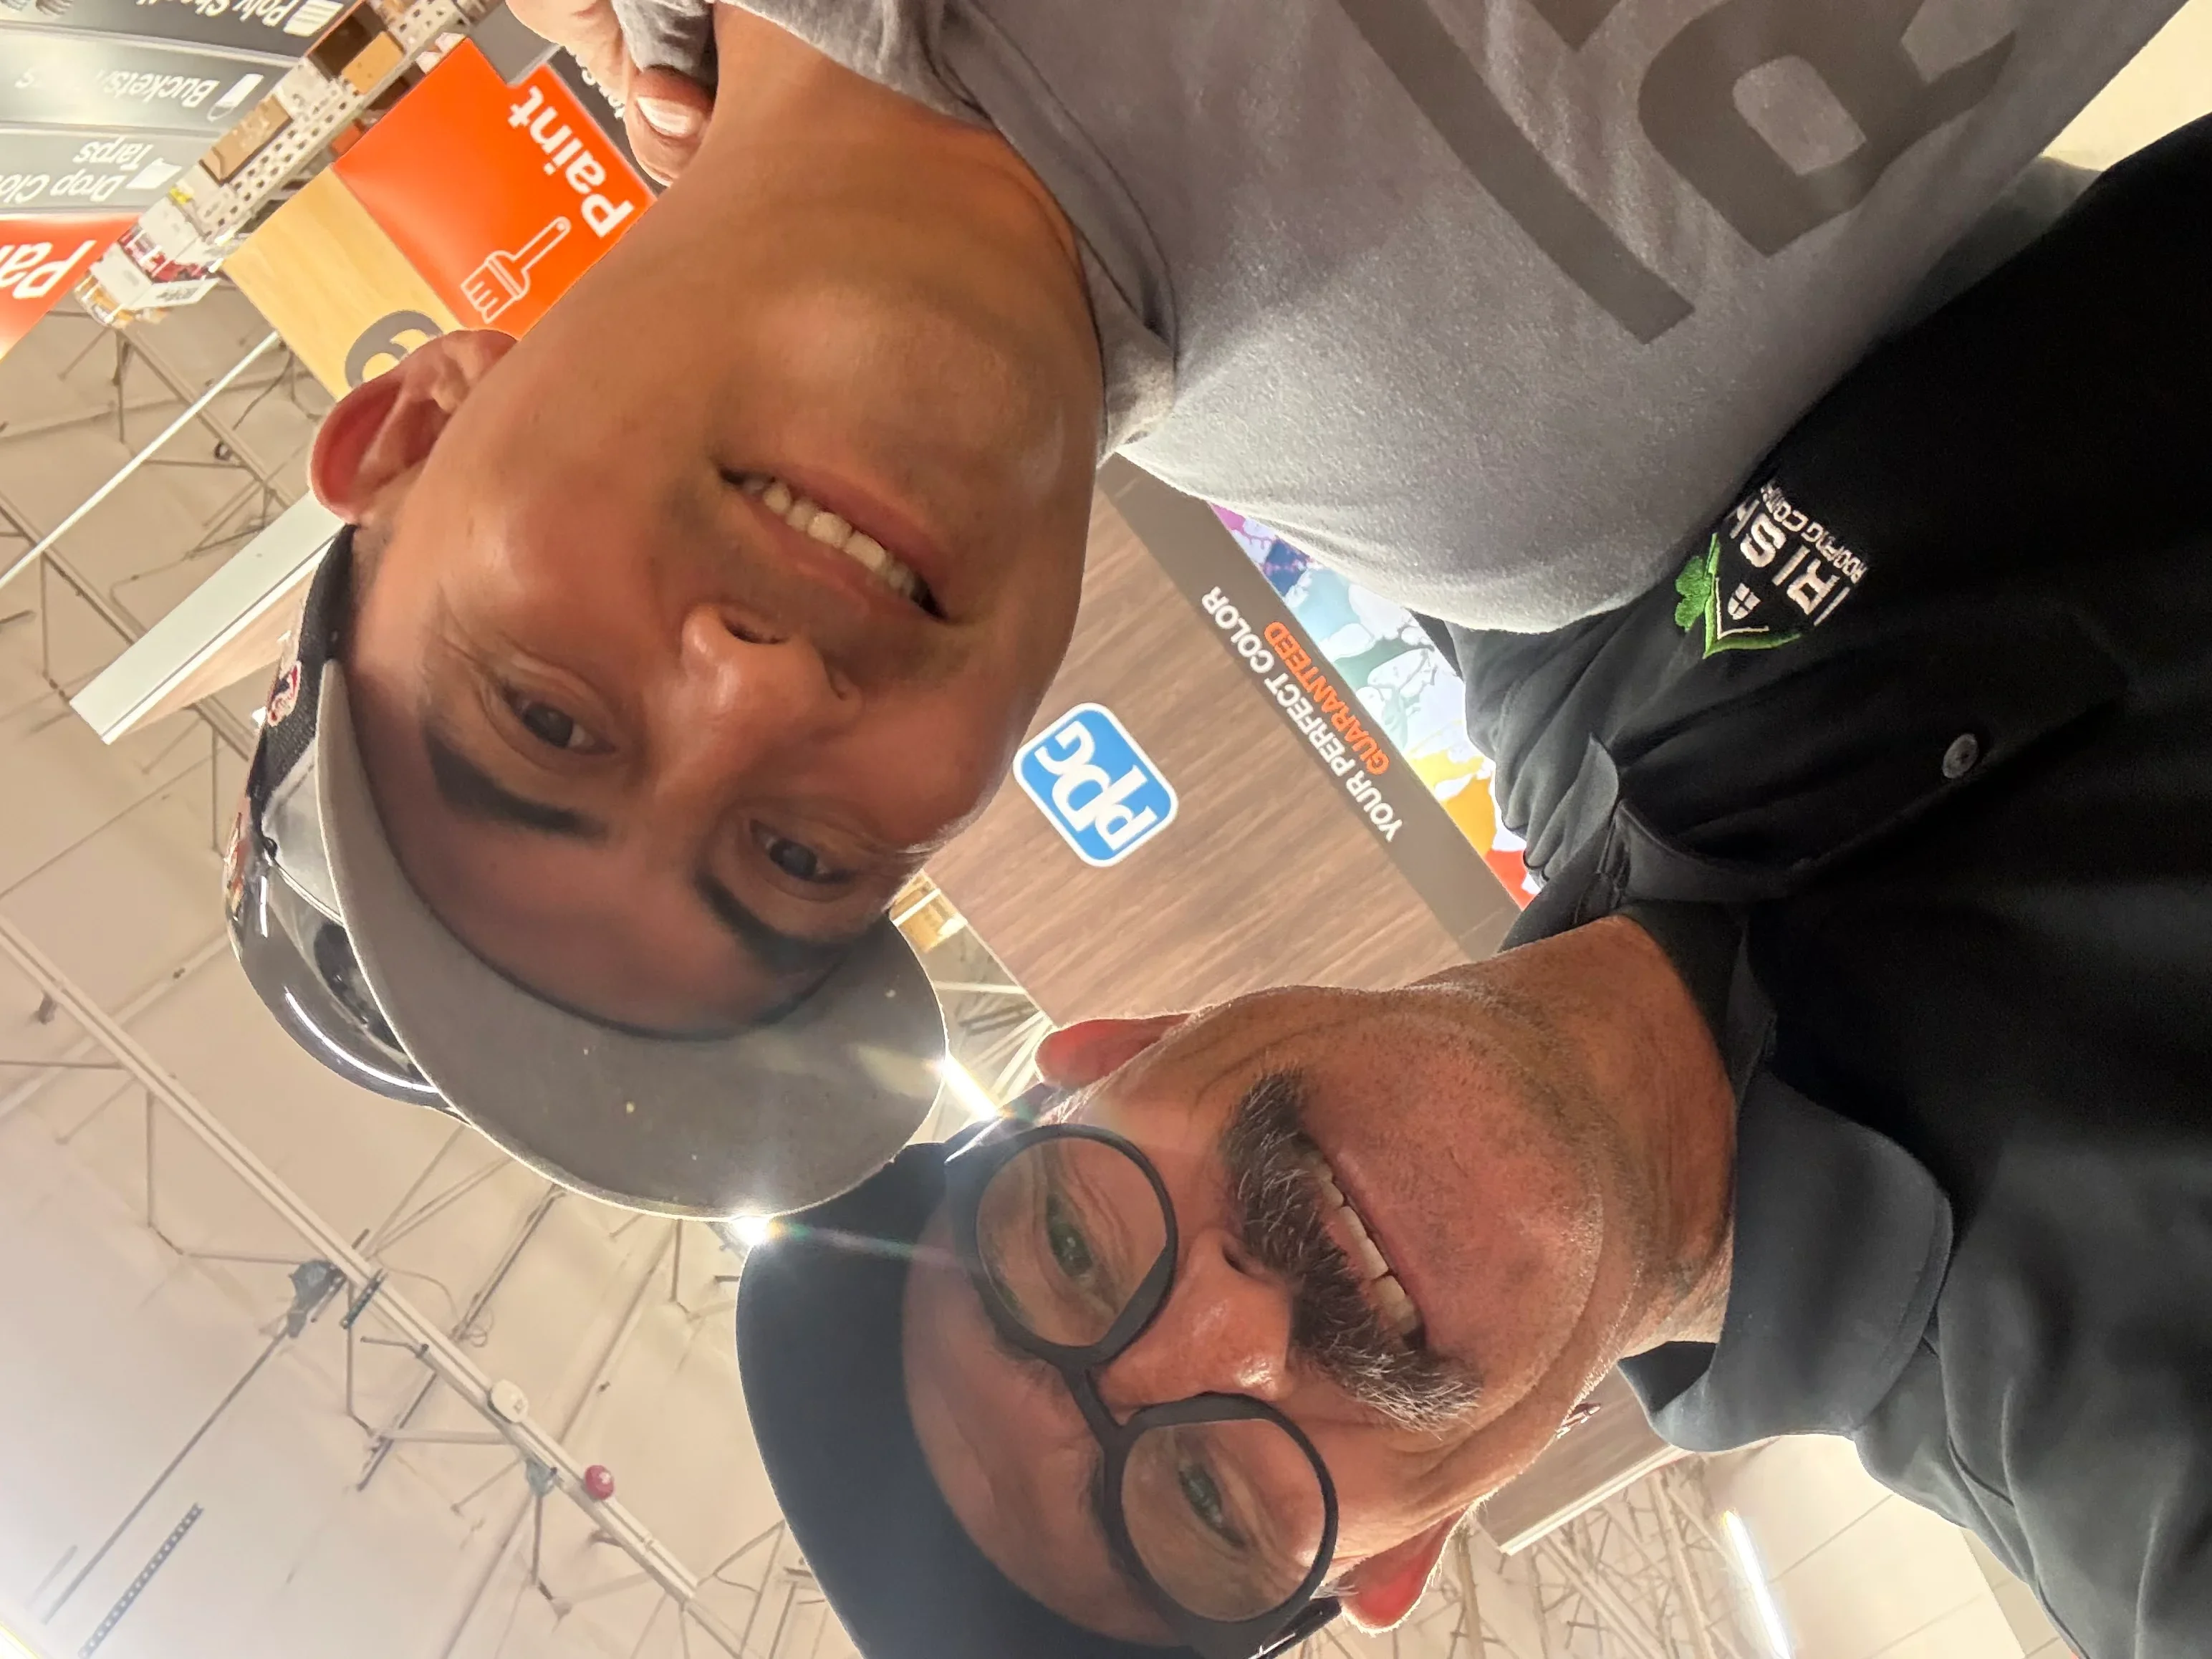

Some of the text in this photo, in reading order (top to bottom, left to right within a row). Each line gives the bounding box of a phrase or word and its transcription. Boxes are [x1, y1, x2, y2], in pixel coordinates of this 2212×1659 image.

[49, 168, 128, 202] Drop
[72, 135, 154, 171] Tarps
[507, 85, 635, 239] Paint
[1201, 586, 1403, 842] YOUR PERFECT COLOR
[1264, 621, 1390, 775] GUARANTEED
[1034, 721, 1158, 852] PPG
